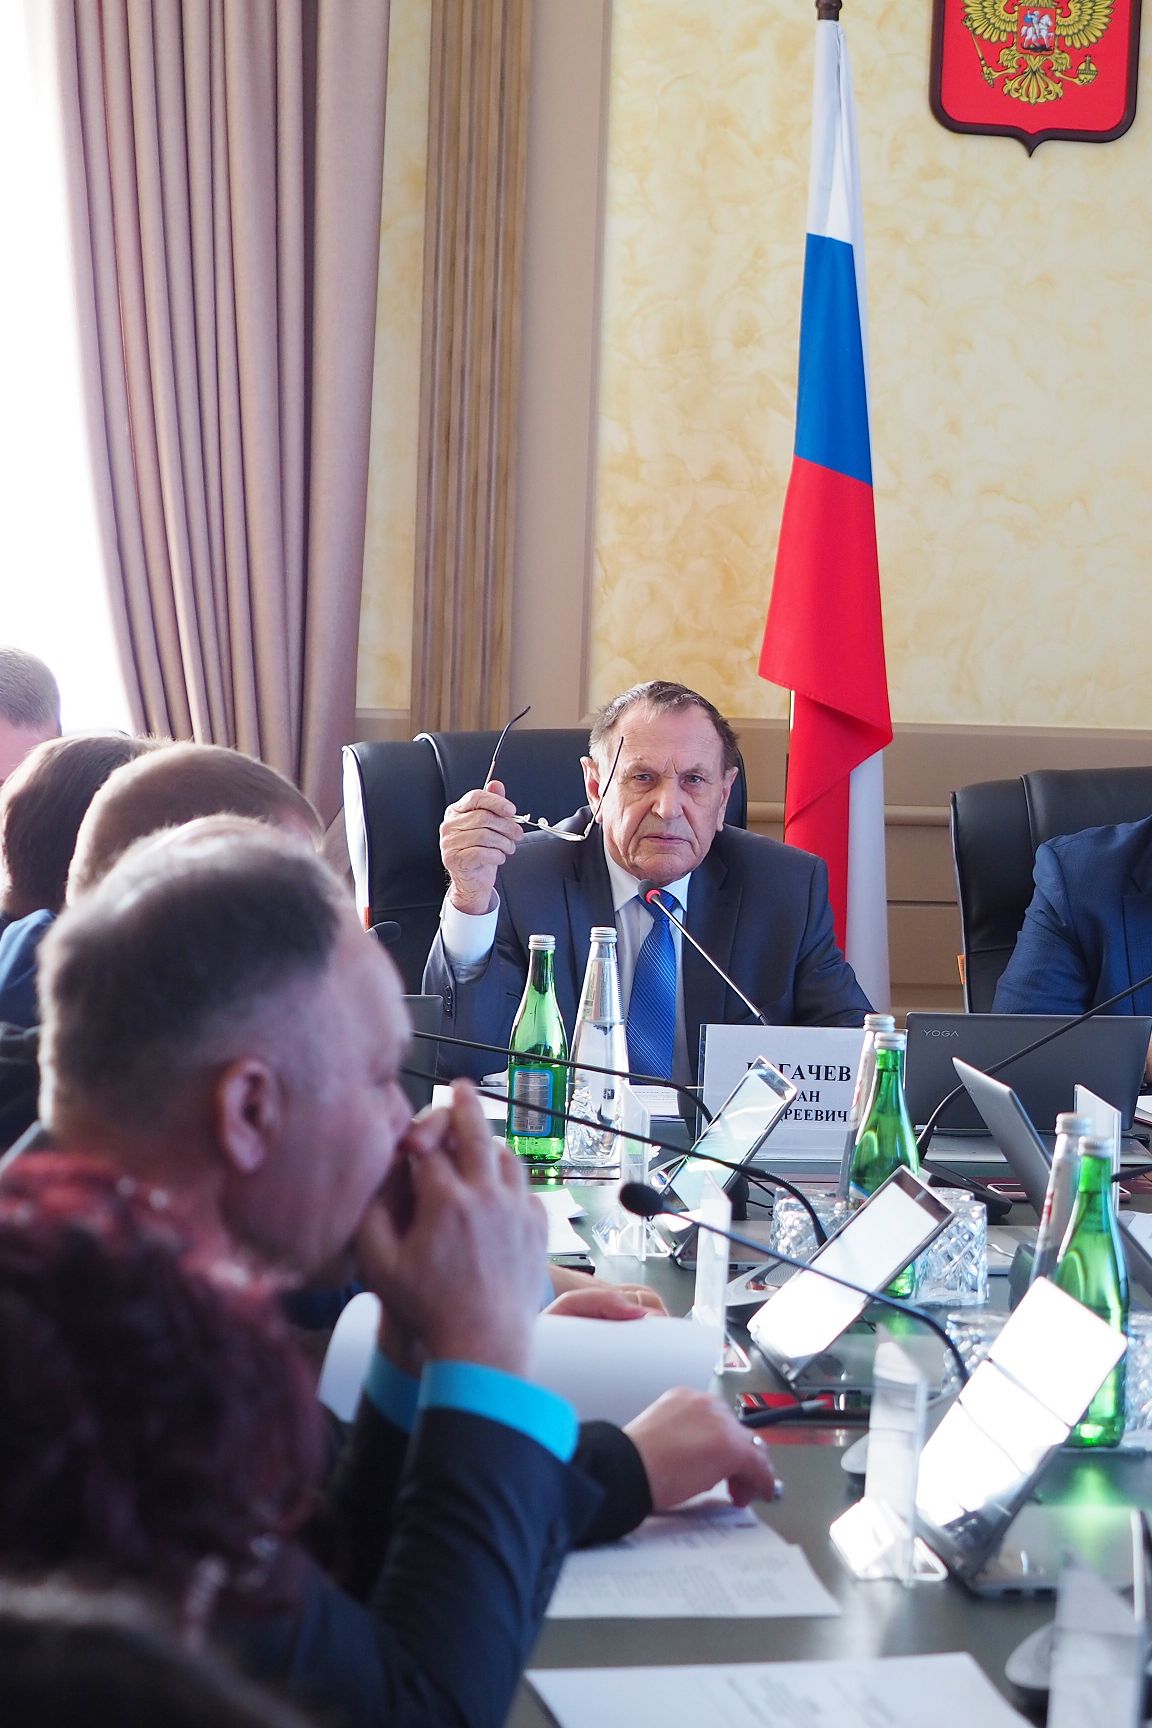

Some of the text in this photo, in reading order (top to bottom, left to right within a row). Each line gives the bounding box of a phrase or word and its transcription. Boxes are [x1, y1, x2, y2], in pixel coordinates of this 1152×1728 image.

[923, 1029, 959, 1038] YOGA
[746, 1062, 851, 1082] ГАЧЕВ
[794, 1090, 821, 1103] АН
[779, 1108, 848, 1122] РЕЕВИЧ
